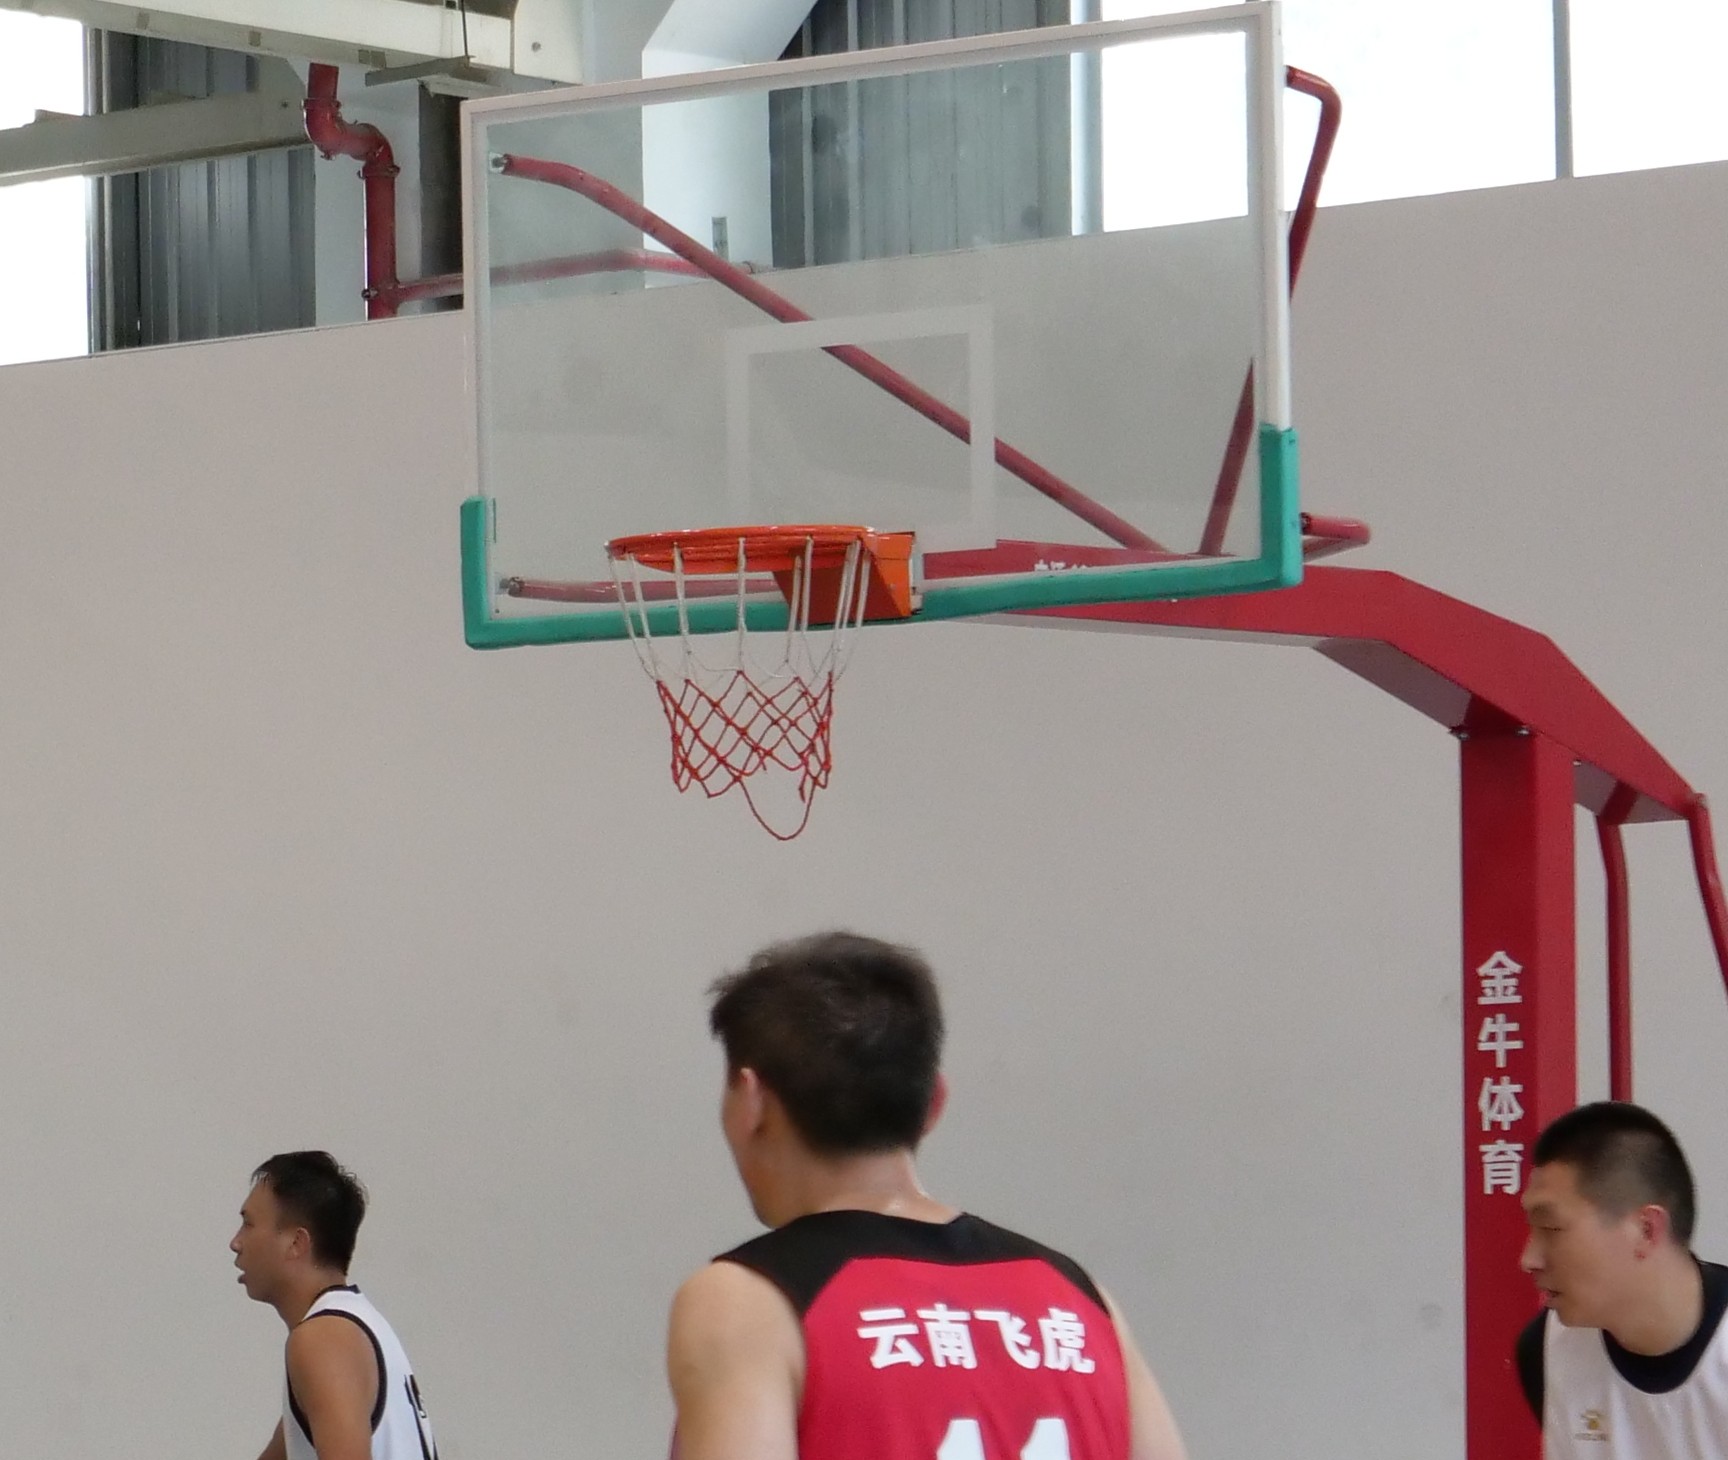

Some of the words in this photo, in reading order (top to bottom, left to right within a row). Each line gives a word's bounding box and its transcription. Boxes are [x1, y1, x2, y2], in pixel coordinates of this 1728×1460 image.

[1476, 951, 1525, 1195] 金牛体育
[857, 1303, 1096, 1374] 云南飞虎
